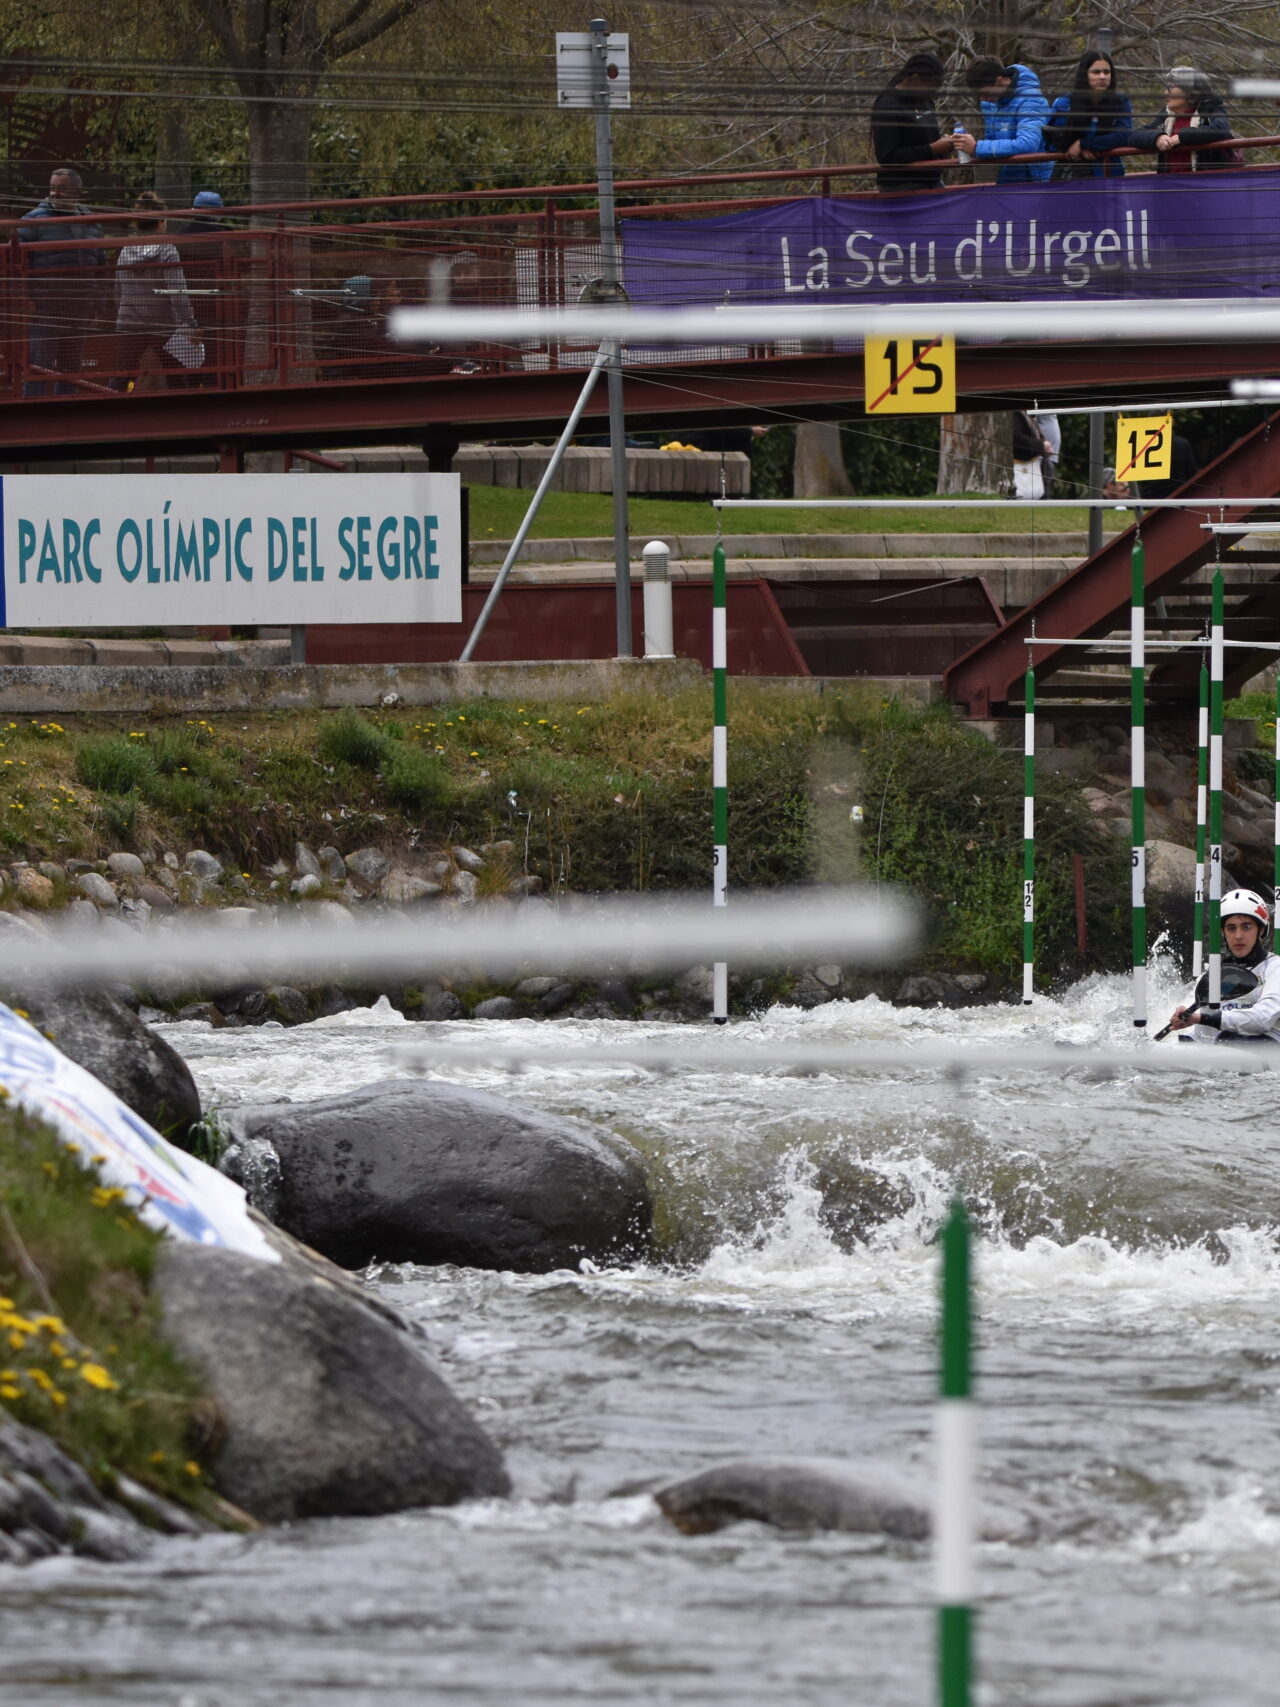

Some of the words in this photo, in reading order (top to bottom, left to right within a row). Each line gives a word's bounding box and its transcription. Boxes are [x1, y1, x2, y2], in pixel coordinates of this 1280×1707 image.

[780, 236, 831, 293] La
[844, 230, 938, 289] Seu
[953, 209, 1153, 289] d’Urgell
[882, 339, 944, 397] 15
[1128, 430, 1164, 469] 12
[18, 517, 102, 584] PARC
[115, 500, 254, 584] OLÍMPIC
[267, 516, 325, 582] DEL
[337, 515, 441, 582] SEGRE
